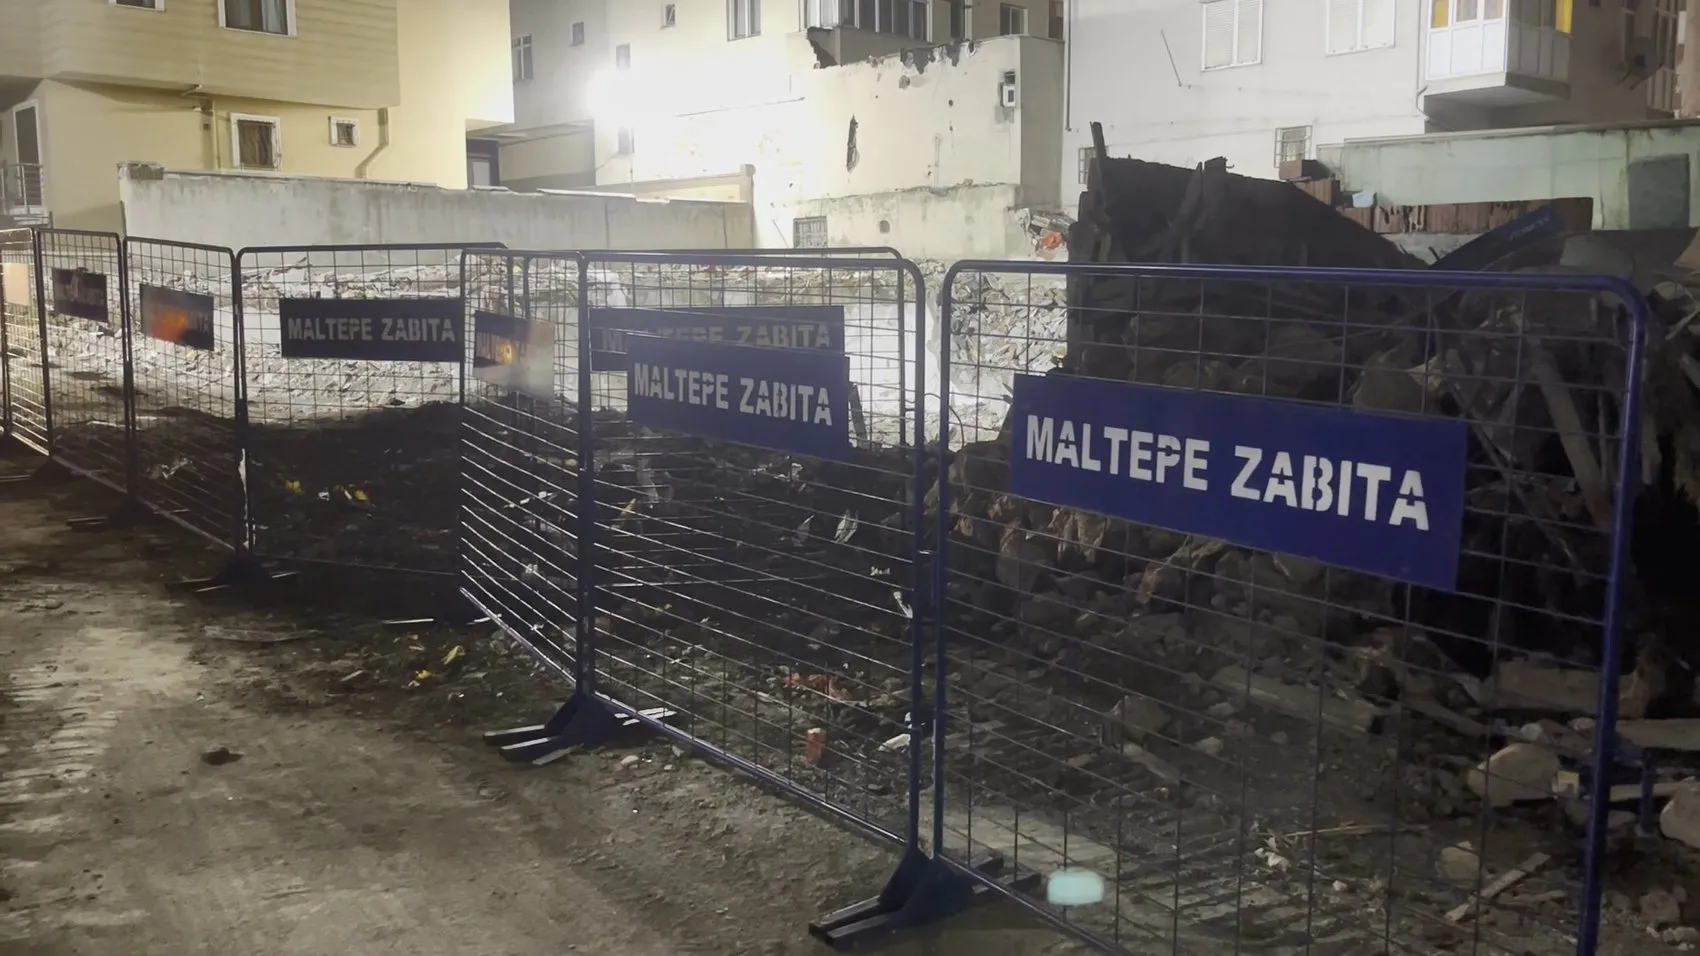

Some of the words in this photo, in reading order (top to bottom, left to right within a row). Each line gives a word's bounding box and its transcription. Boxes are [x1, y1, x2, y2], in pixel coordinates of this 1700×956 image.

[288, 318, 373, 341] MALTEPE
[381, 318, 456, 342] ZABITA
[634, 362, 729, 410] MALTEPE
[739, 377, 833, 426] ZABITA
[1026, 414, 1211, 491] MALTEPE
[1230, 444, 1430, 531] ZABITA
